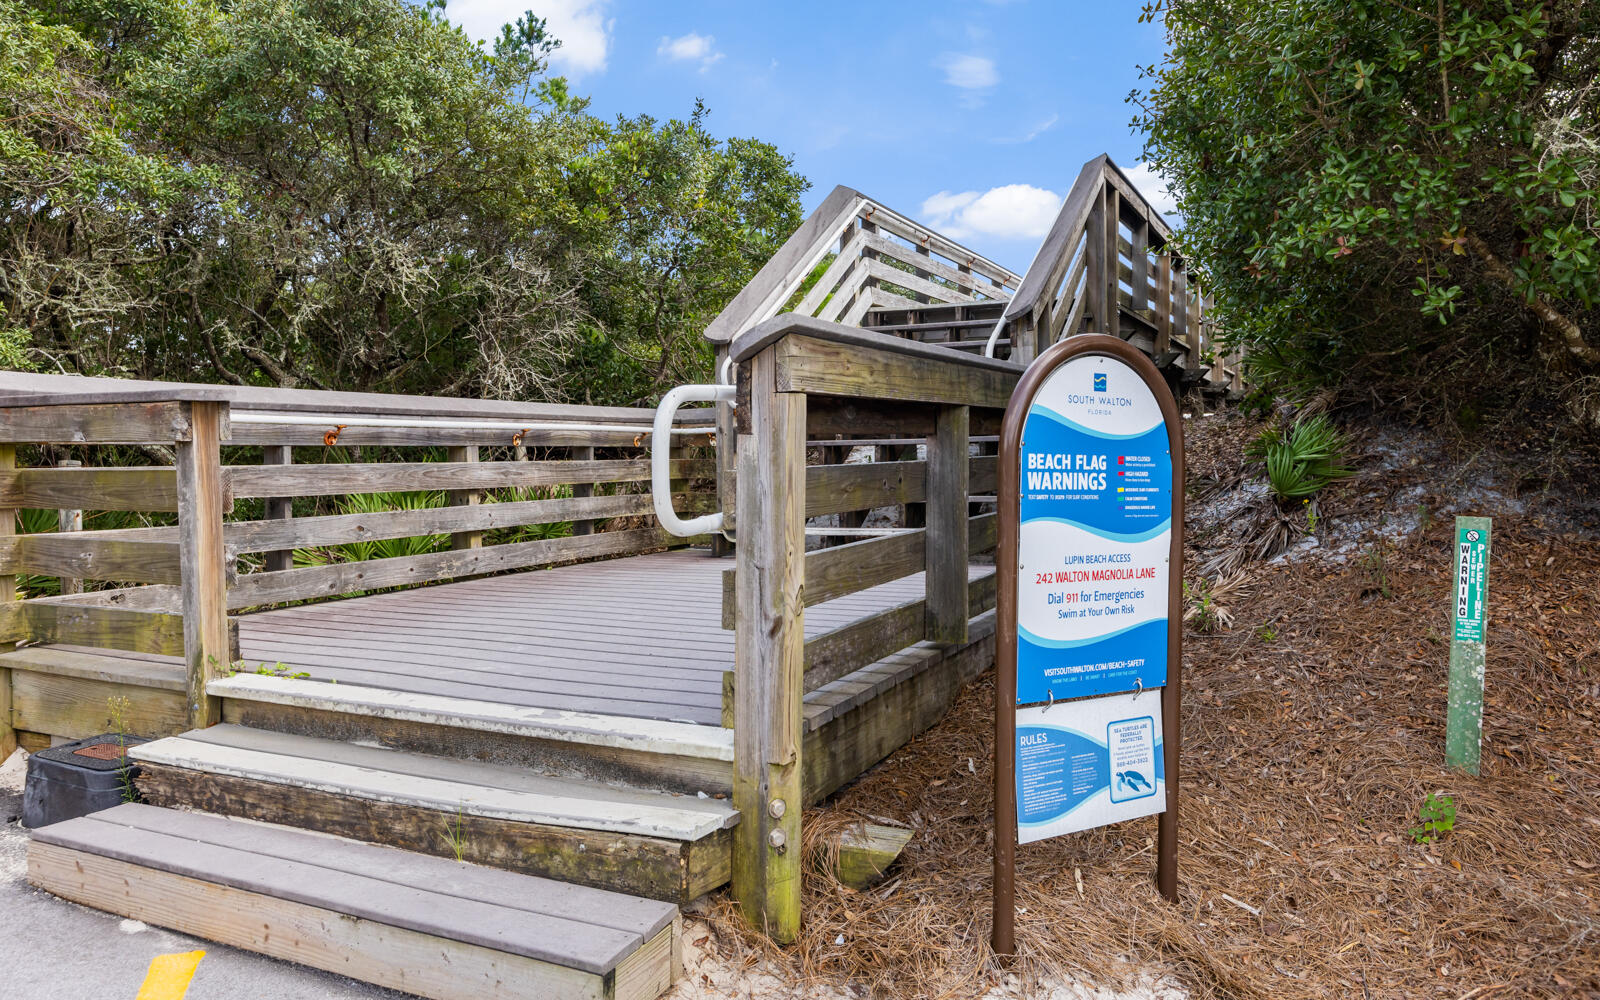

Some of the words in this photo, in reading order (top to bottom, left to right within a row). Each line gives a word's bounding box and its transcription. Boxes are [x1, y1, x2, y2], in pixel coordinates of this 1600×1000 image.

[1068, 394, 1094, 404] SOUTH
[1099, 397, 1132, 406] WALTON
[1028, 454, 1071, 469] BEACH
[1076, 454, 1106, 470] FLAG
[1027, 472, 1107, 490] WARNINGS
[1065, 556, 1084, 564] LUPIN
[1086, 555, 1106, 564] BEACH
[1108, 554, 1131, 563] ACCESS
[1036, 573, 1053, 584] 242
[1055, 570, 1090, 583] WALTON
[1092, 569, 1133, 581] MAGNOLIA
[1136, 567, 1156, 579] LANE
[1458, 544, 1470, 616] WARNING
[1474, 544, 1485, 619] PIPELINE
[1048, 592, 1064, 605] Dial
[1066, 593, 1078, 604] 911
[1080, 591, 1092, 602] for
[1094, 588, 1144, 603] Emergencies
[1058, 609, 1077, 619] Swim
[1079, 609, 1086, 618] at
[1088, 608, 1103, 617] Your
[1104, 606, 1120, 615] Own
[1121, 604, 1135, 614] Risk
[1044, 659, 1145, 677] VISITSOUTHWALTON.COM/BEACH-SAFETY
[1020, 733, 1047, 746] RULES
